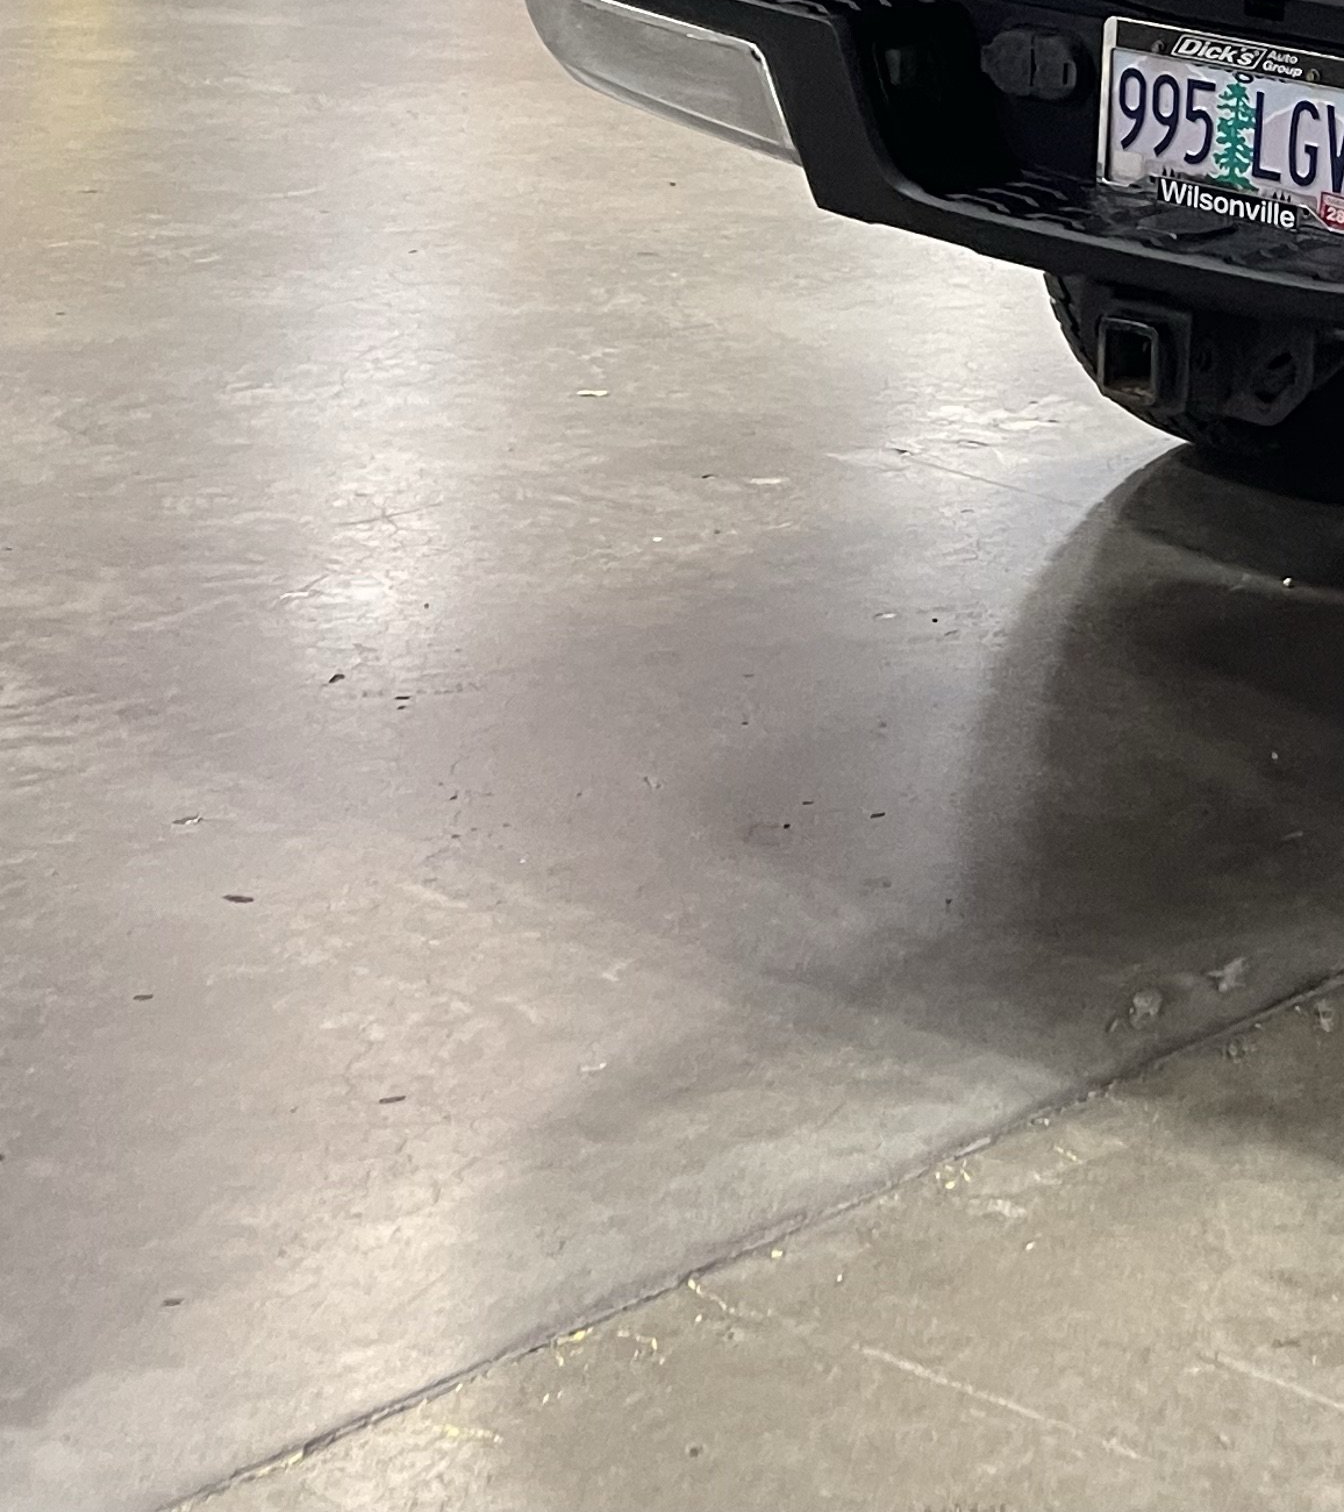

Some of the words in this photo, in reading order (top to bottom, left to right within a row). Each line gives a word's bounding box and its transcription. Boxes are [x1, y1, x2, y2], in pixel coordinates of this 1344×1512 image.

[1177, 38, 1255, 68] Dick's
[1266, 50, 1299, 65] Auto
[1262, 60, 1303, 78] Group
[1118, 66, 1217, 165] 995
[1160, 178, 1296, 229] Wilsonville
